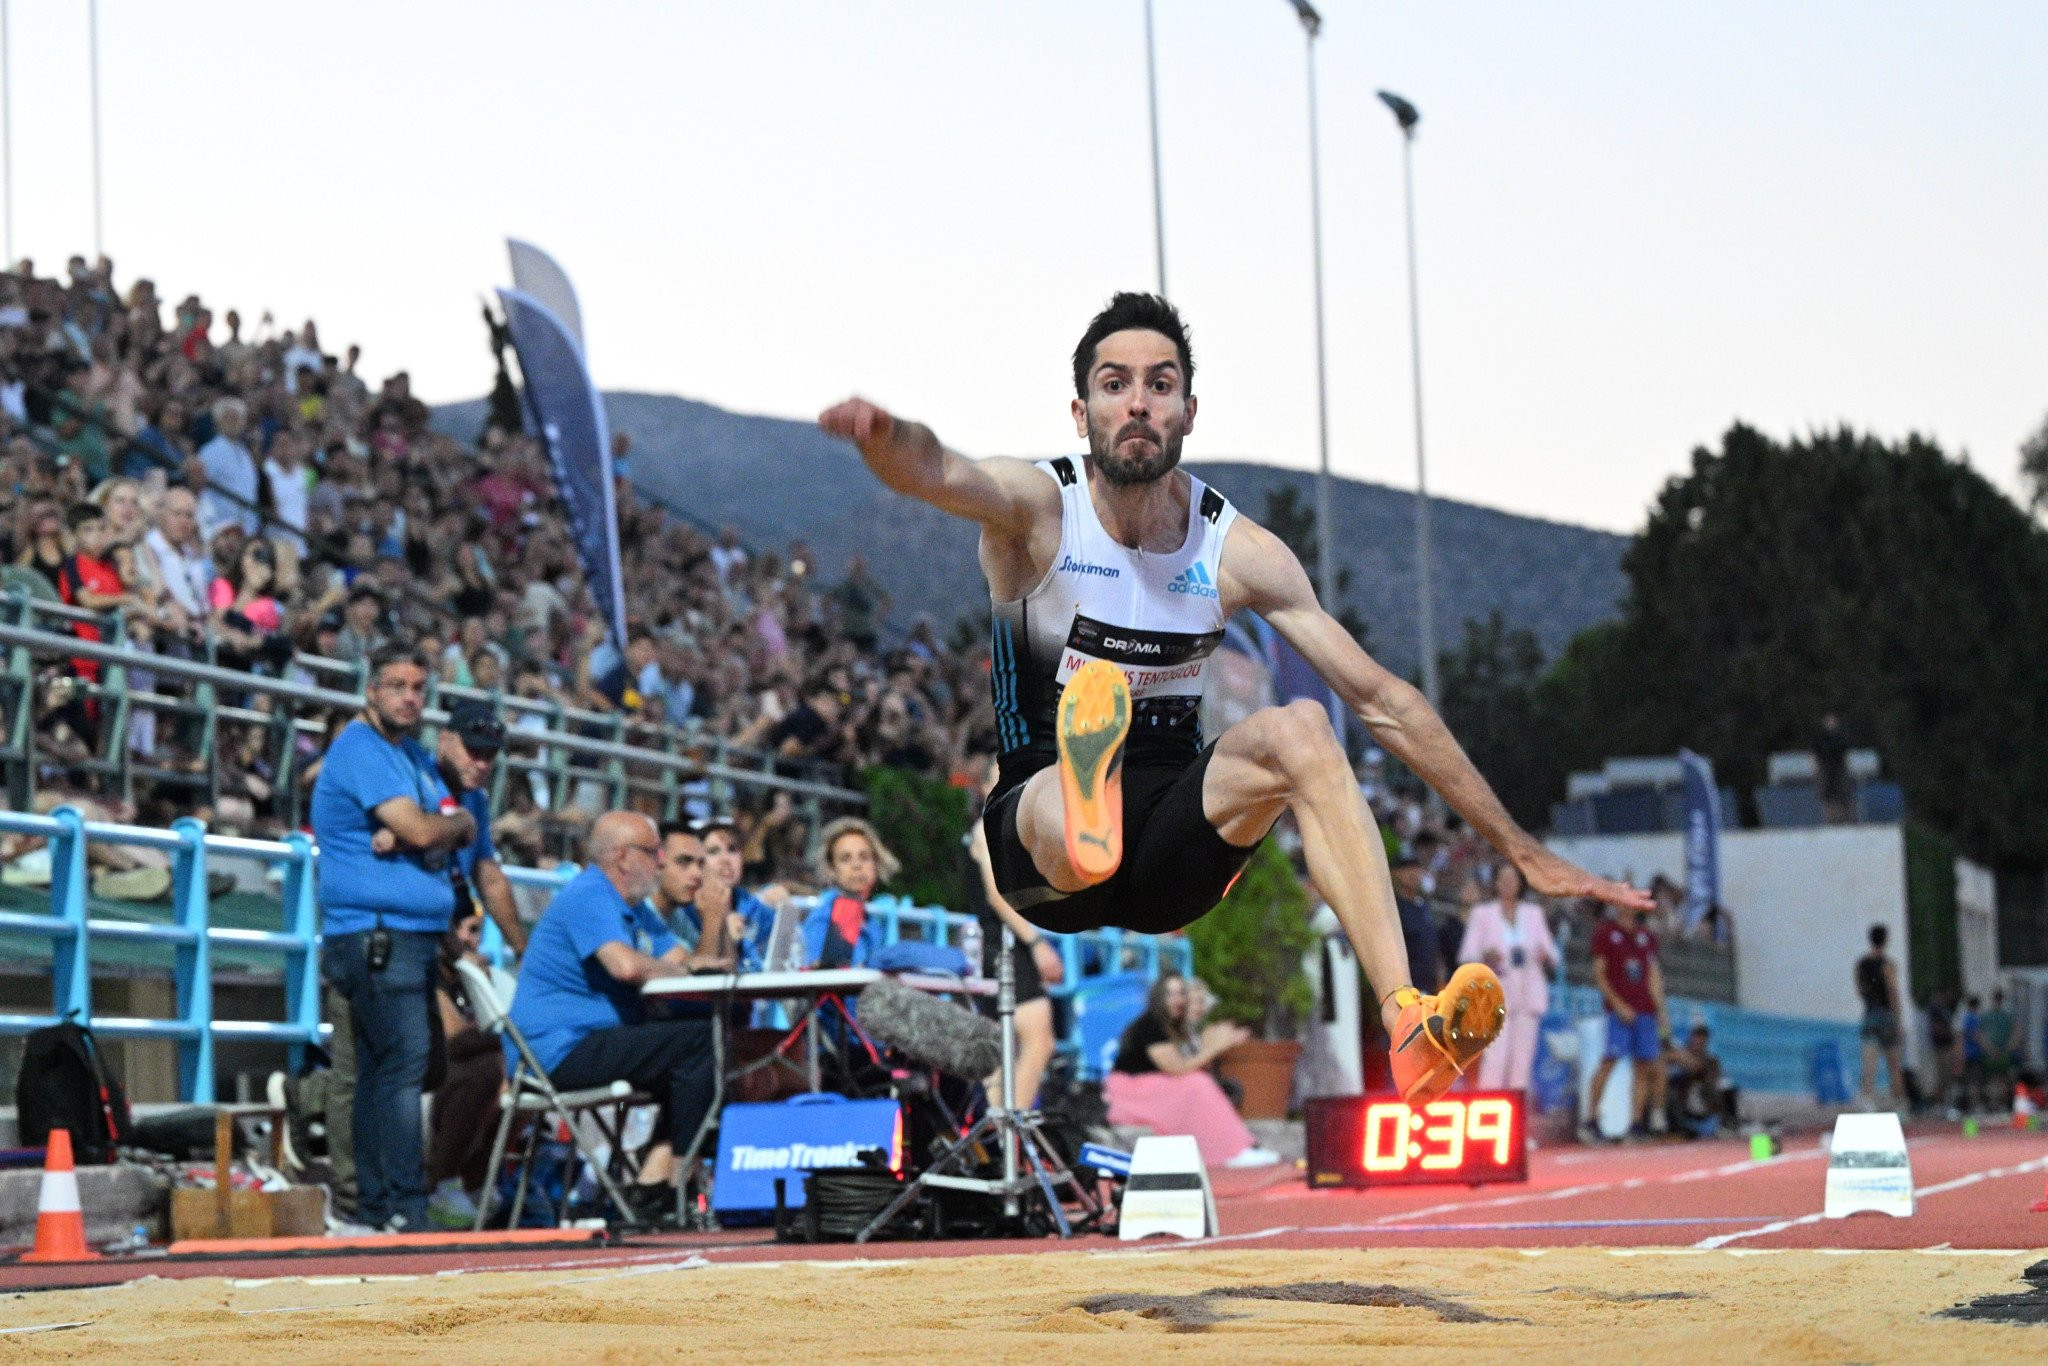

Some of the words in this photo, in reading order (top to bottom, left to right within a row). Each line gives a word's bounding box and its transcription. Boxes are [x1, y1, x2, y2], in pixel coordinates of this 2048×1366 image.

[1059, 556, 1120, 578] Stoiximan
[1168, 581, 1217, 598] adidas
[1364, 1100, 1512, 1171] 0:39
